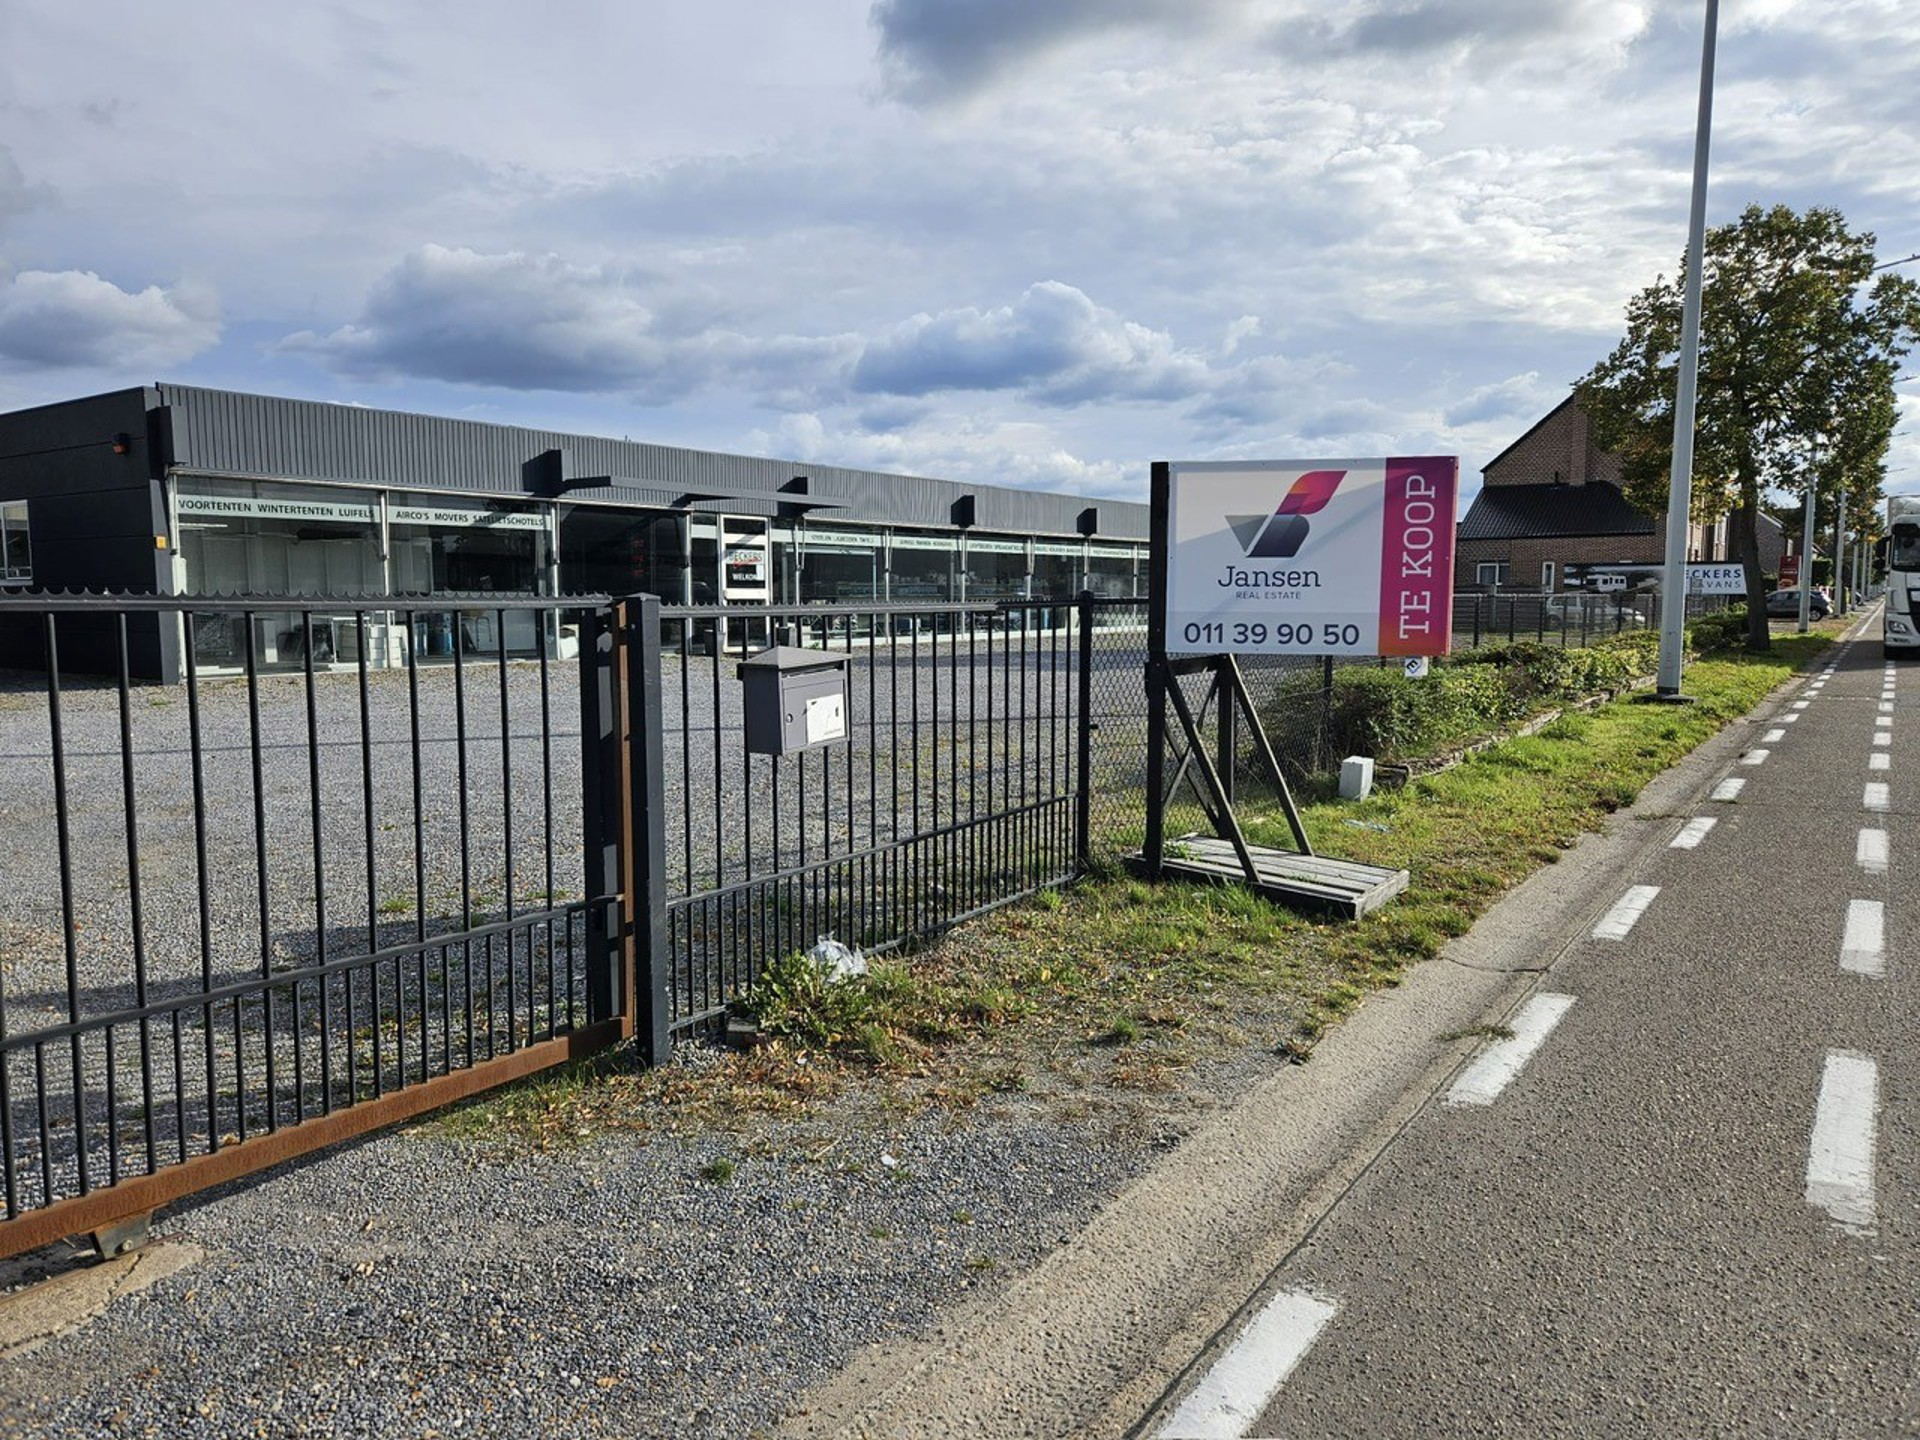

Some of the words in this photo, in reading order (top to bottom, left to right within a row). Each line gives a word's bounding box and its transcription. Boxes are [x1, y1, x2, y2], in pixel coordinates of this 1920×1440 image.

[179, 499, 251, 512] VOORTENTEN
[257, 503, 334, 517] WINTERTENTEN
[338, 508, 375, 519] LUIFELS
[395, 510, 430, 521] AIRCO'S
[434, 512, 469, 523] MOVERS
[1401, 474, 1436, 578] KOOP
[1217, 565, 1321, 587] Jansen
[1685, 568, 1742, 579] ECKERS
[1235, 591, 1262, 600] REAL
[1264, 591, 1301, 600] ESTATE
[1399, 590, 1430, 639] TE
[1184, 622, 1224, 645] 011
[1232, 623, 1268, 645] 39
[1276, 623, 1313, 645] 90
[1323, 624, 1360, 646] 50
